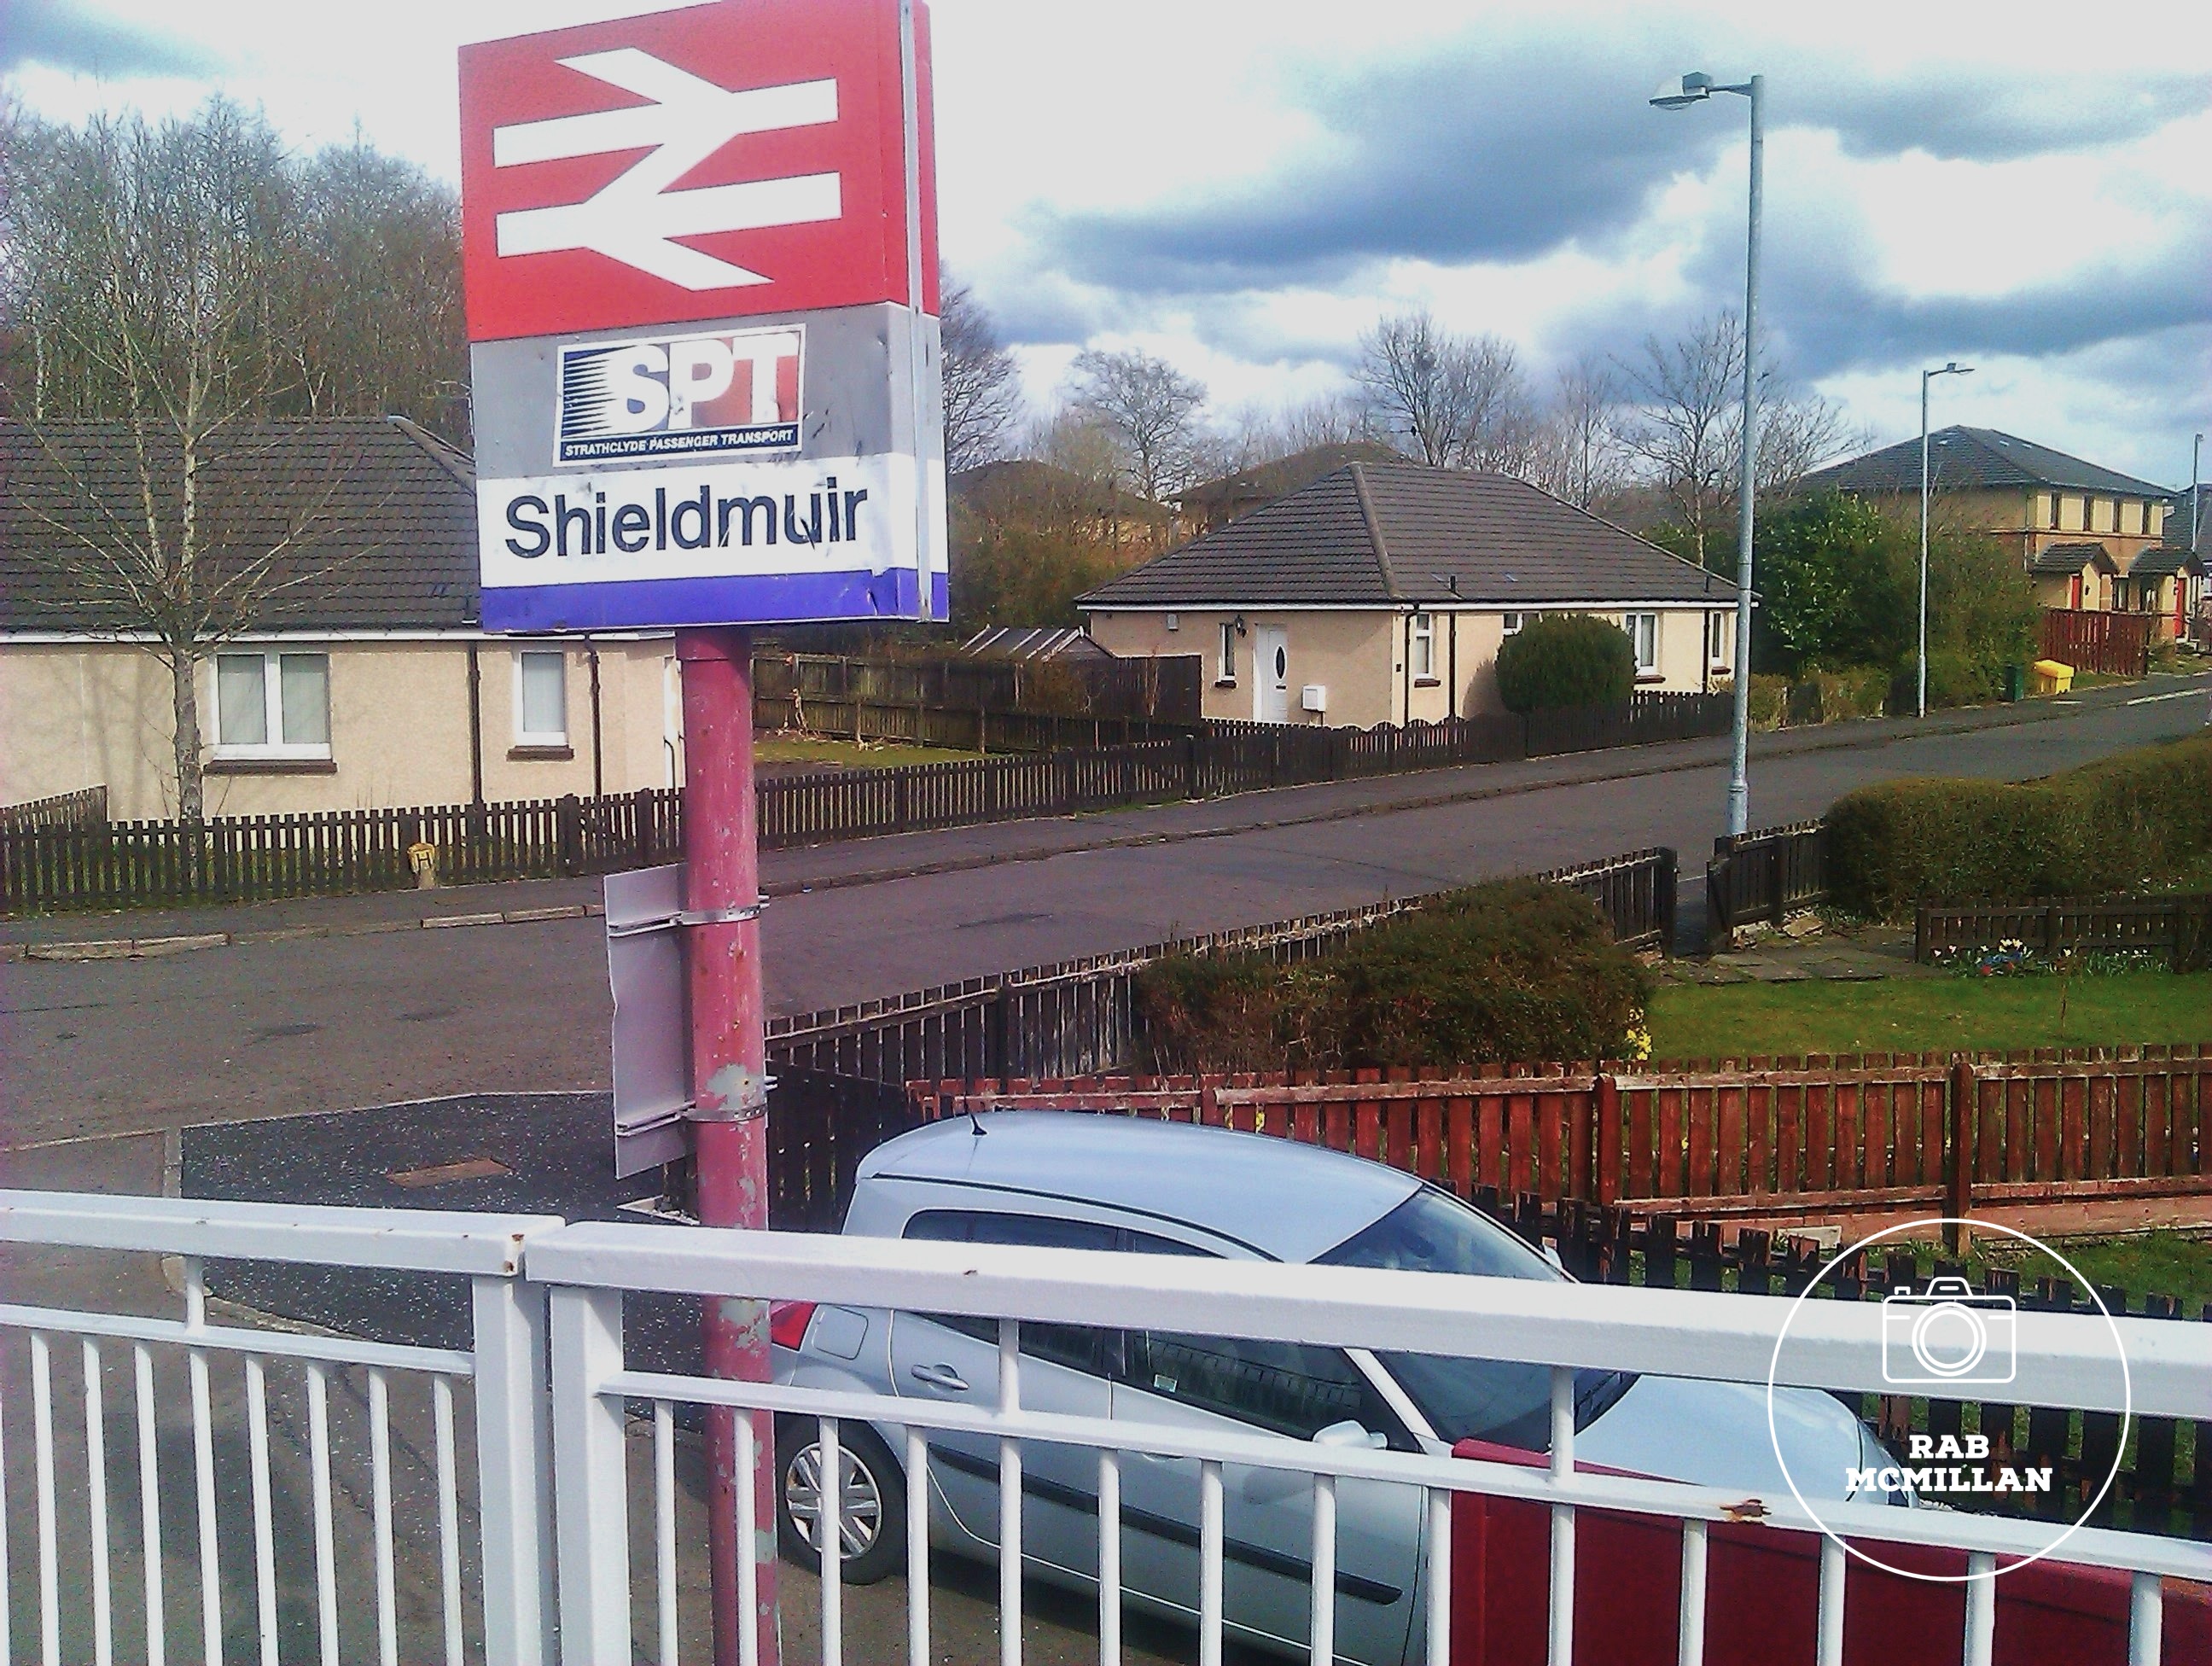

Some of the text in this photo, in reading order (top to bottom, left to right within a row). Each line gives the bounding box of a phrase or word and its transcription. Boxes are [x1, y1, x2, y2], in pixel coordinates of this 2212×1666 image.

[599, 332, 799, 434] SPT
[564, 428, 795, 457] STRATHCLYDE PASSENGER TRANSPORT
[504, 476, 869, 559] Shieldmuir
[415, 851, 433, 875] H
